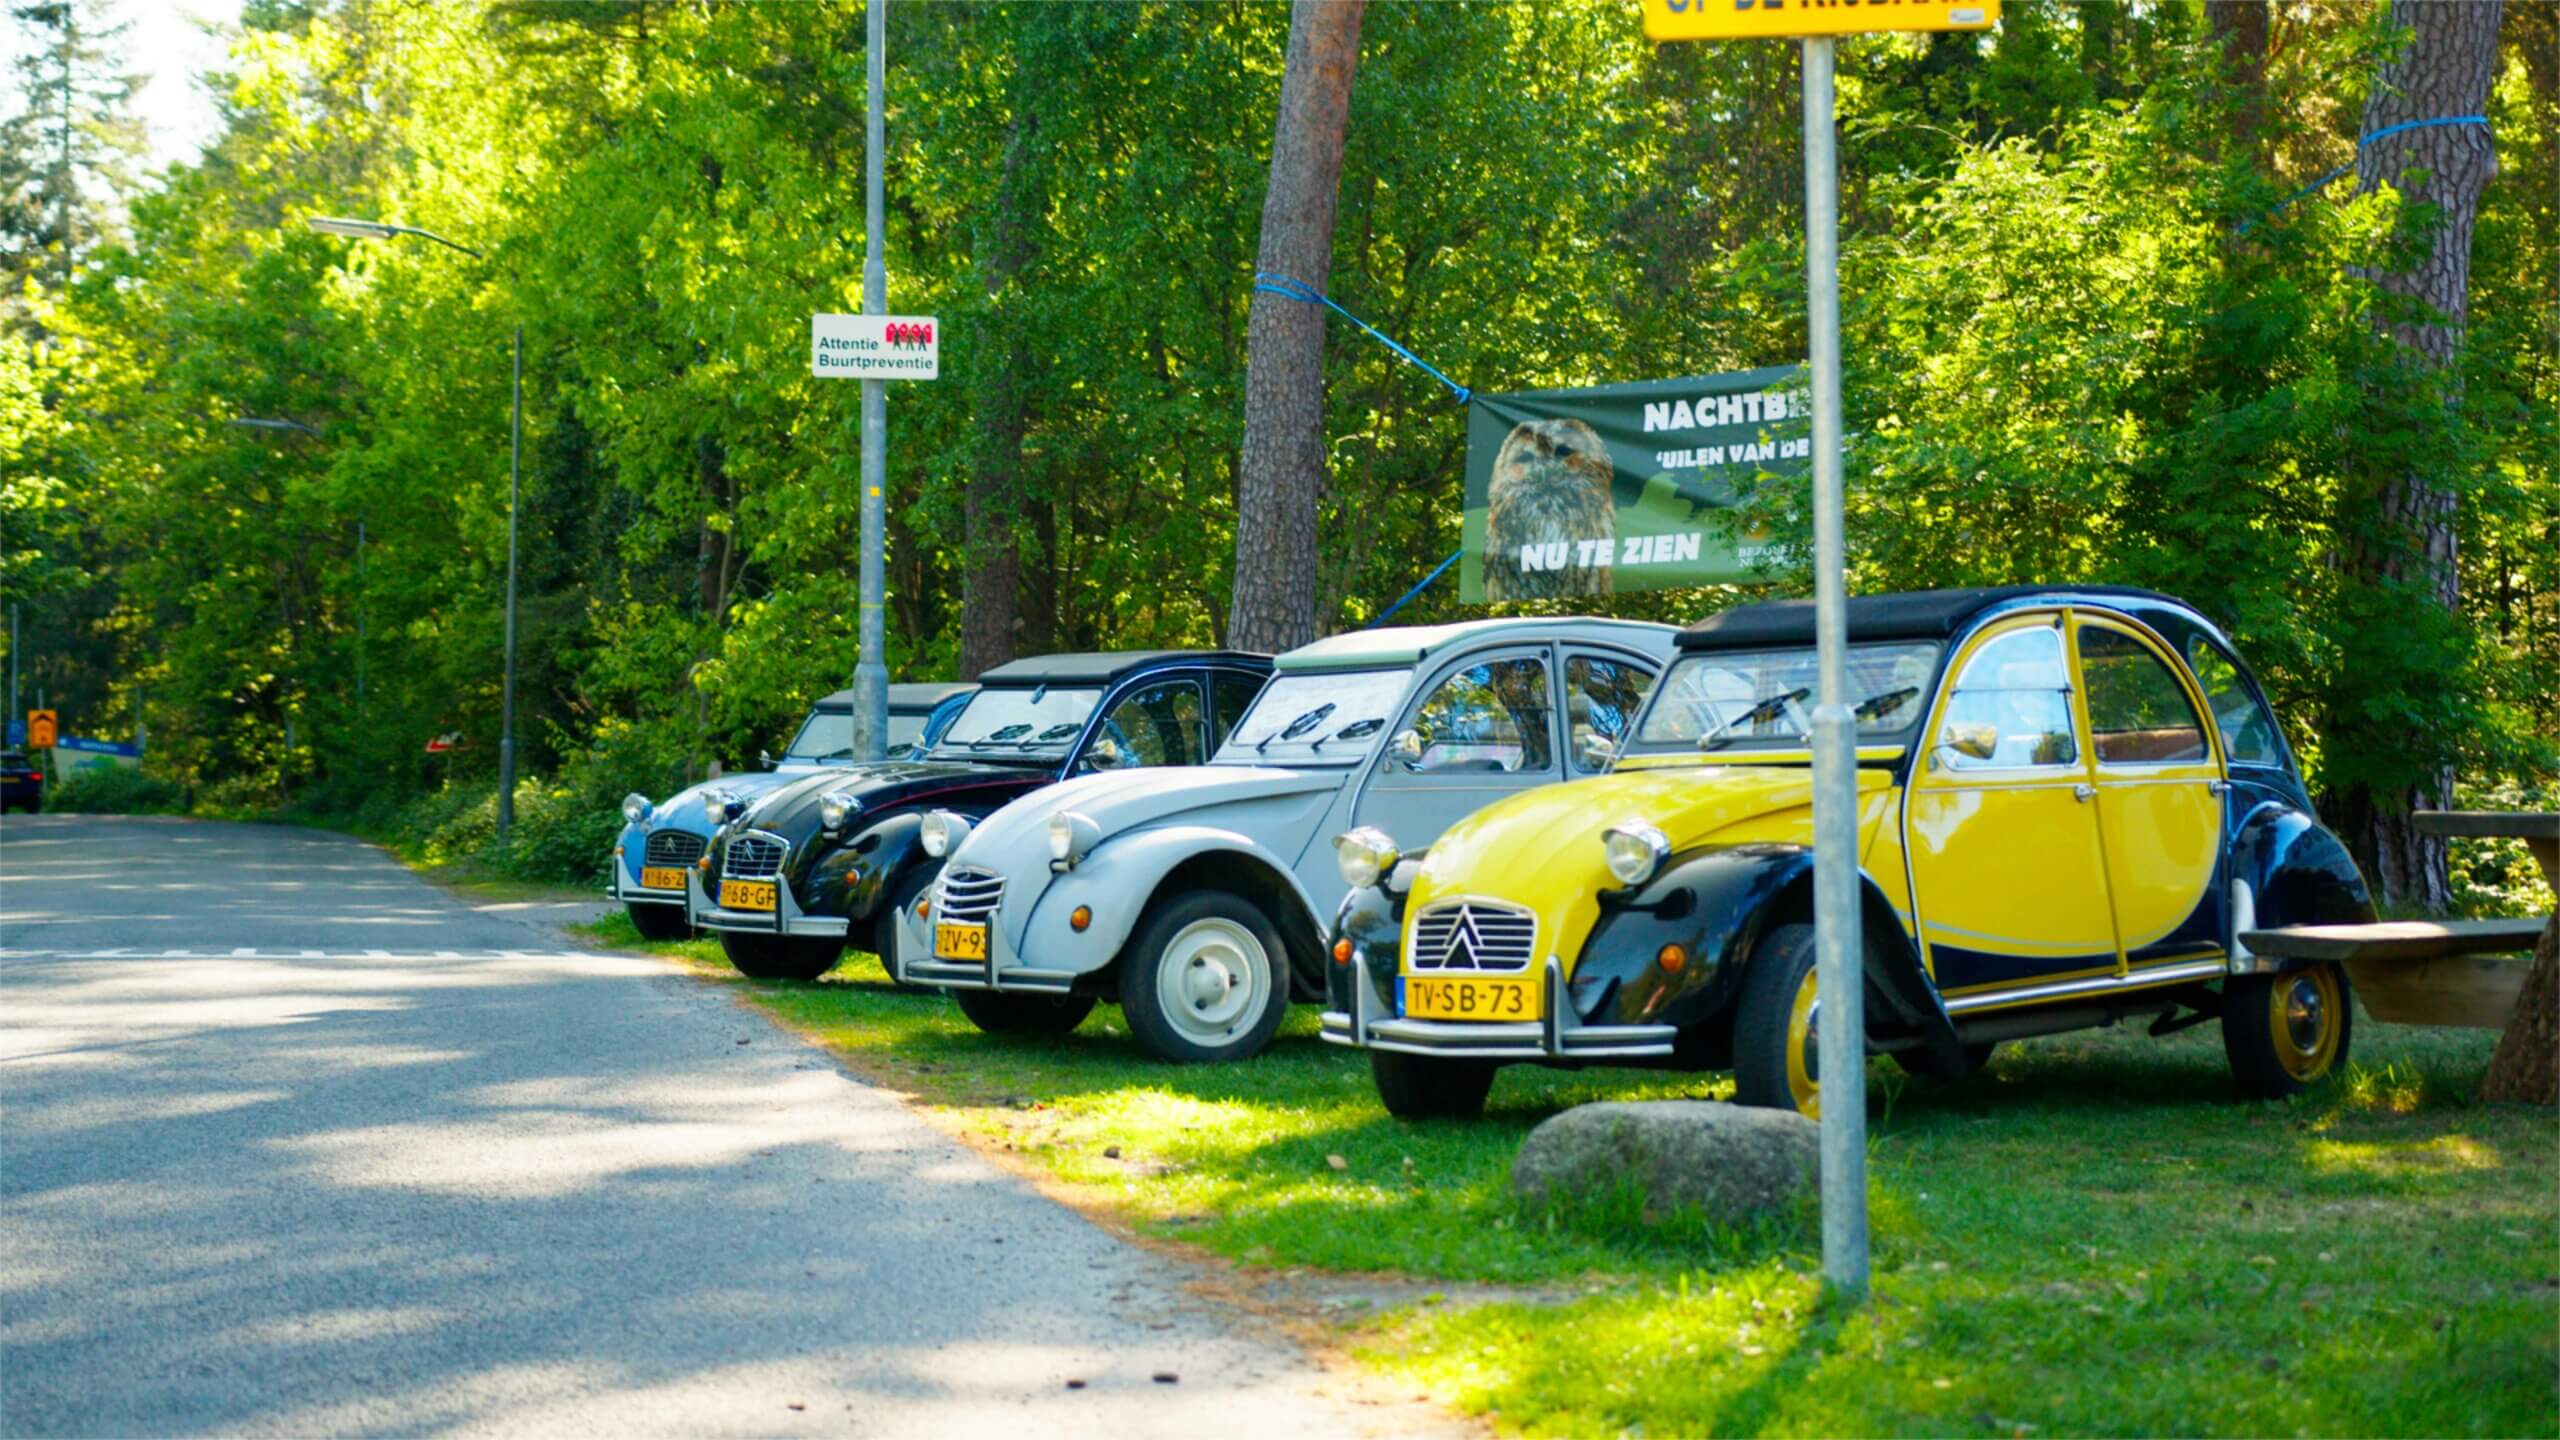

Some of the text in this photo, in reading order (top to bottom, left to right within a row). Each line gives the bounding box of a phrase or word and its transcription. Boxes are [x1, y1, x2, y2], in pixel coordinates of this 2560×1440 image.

[819, 337, 879, 350] Attentie
[819, 354, 933, 369] Buurtpreventie
[1729, 441, 1775, 463] VAN
[1780, 438, 1809, 458] DE
[1521, 532, 1701, 572] NU TE ZIEN
[1413, 983, 1523, 1013] TV-SB-73
